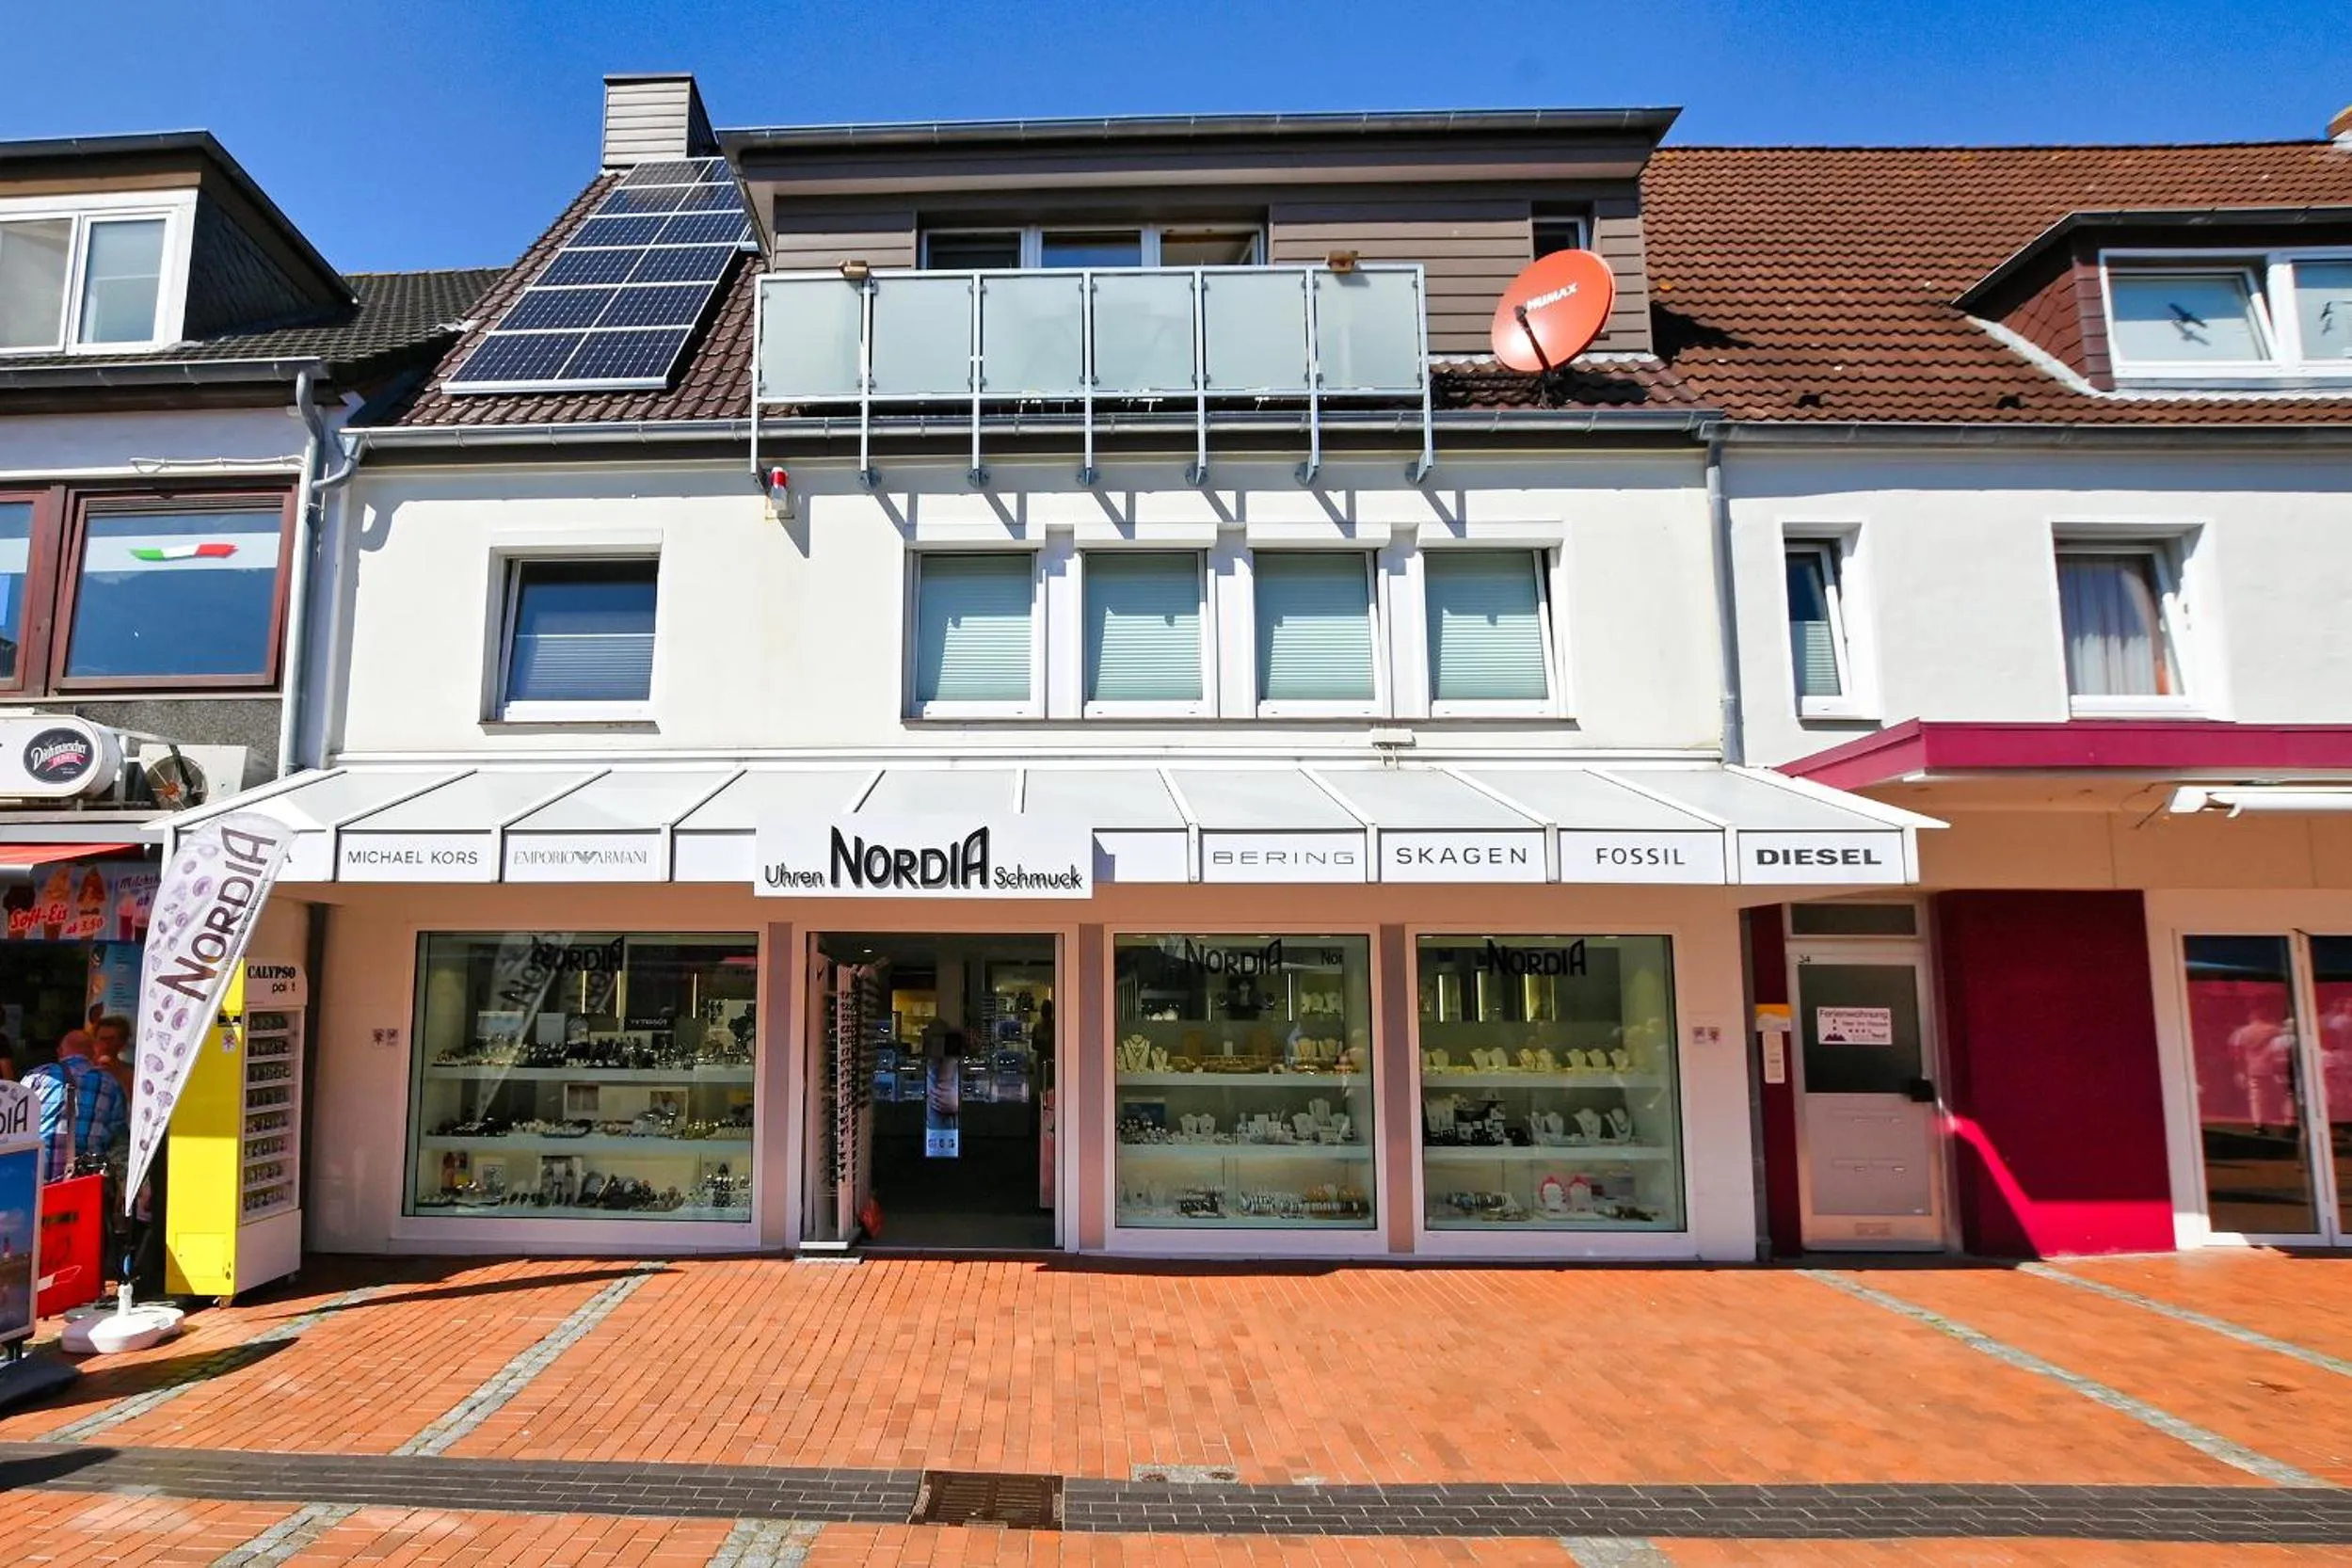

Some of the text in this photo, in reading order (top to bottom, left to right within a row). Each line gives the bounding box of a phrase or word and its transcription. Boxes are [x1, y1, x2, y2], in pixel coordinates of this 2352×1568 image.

[347, 850, 478, 865] MICHAEL KORS
[514, 850, 648, 865] EMPORIO ARMANI
[764, 824, 1083, 890] Uhren NORDIA Schmuck
[1212, 850, 1354, 865] BERING
[1396, 847, 1527, 865] SKAGEN
[1595, 847, 1686, 865] FOSSIL
[1755, 848, 1882, 866] DIESEL
[155, 825, 277, 1001] NORDIA
[1185, 938, 1282, 975] NORDIA
[1487, 938, 1587, 976] NORDIA
[248, 966, 296, 980] CALYPSO
